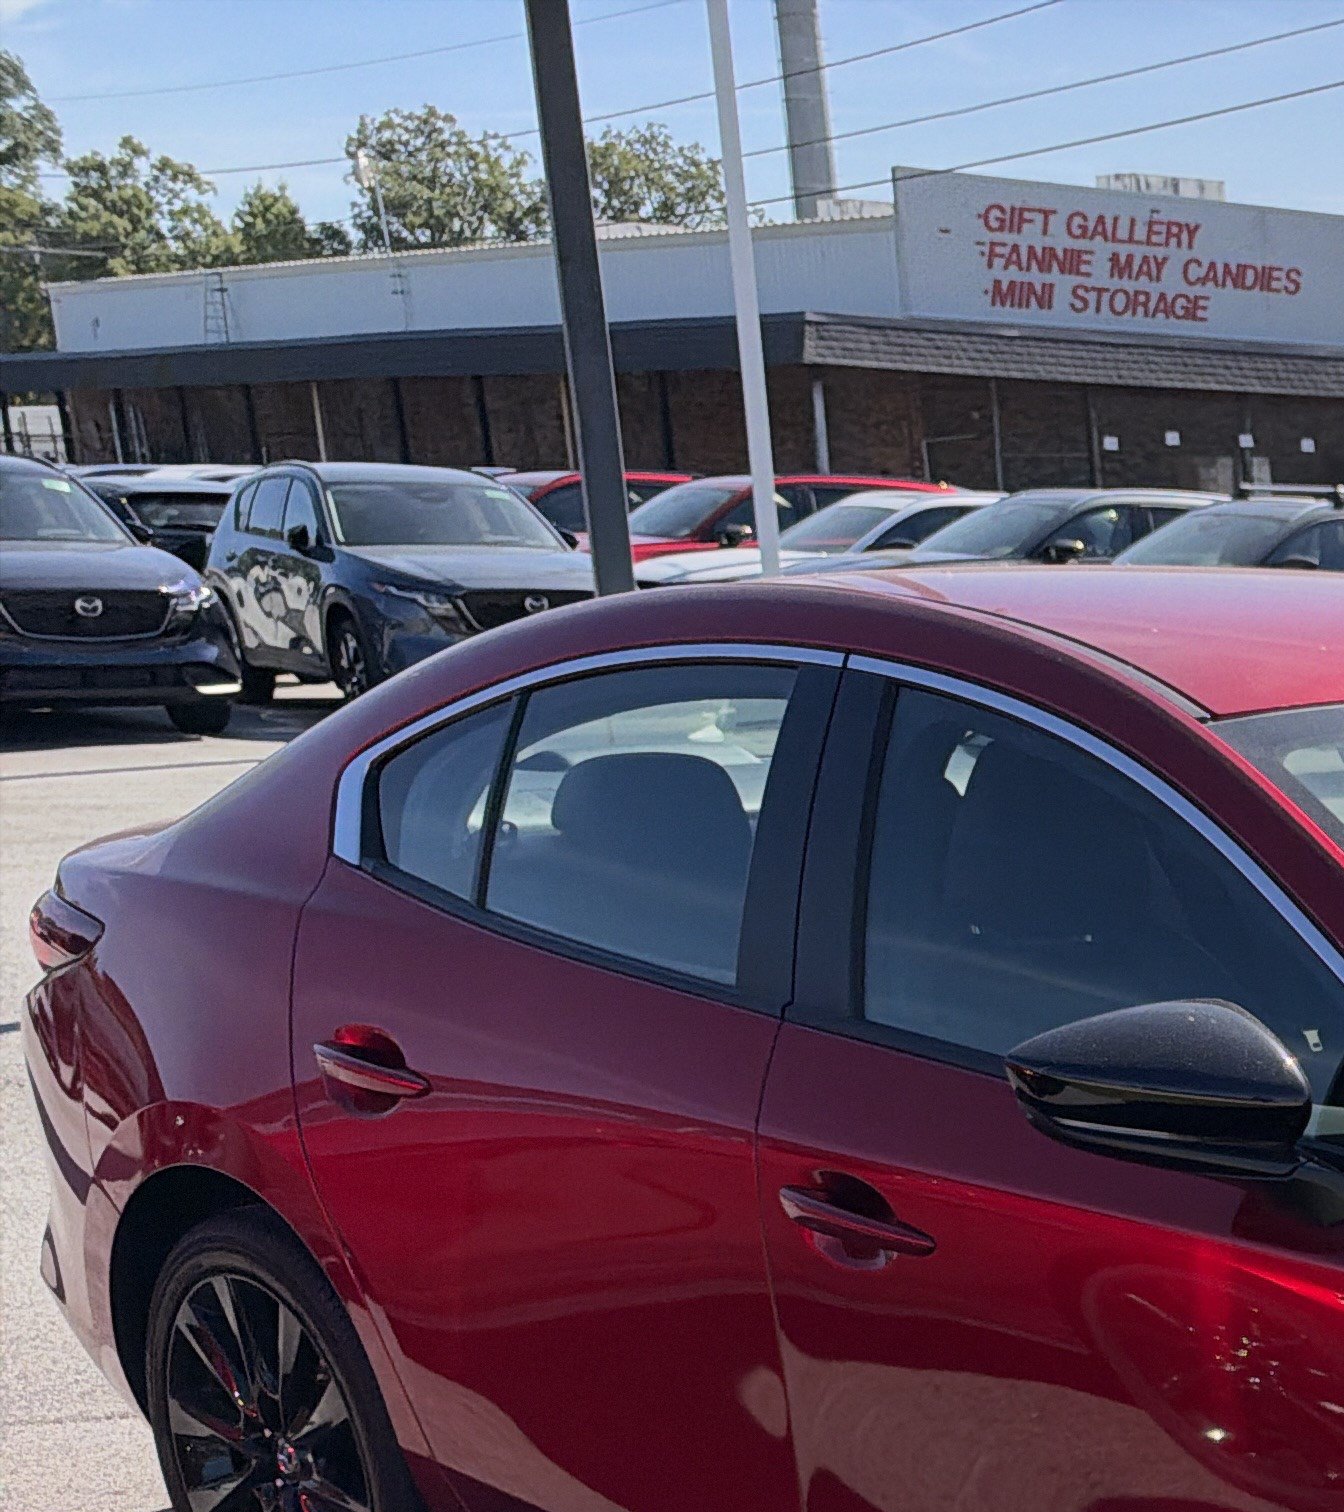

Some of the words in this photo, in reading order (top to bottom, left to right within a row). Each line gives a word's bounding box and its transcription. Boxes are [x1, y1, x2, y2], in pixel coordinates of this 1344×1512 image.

[982, 203, 1057, 236] GIFT
[1066, 211, 1201, 250] GALLERY
[986, 240, 1094, 278] FANNIE
[1108, 252, 1169, 283] MAY
[1182, 259, 1302, 296] CANDIES
[990, 279, 1055, 310] MINI
[1069, 285, 1210, 322] STORAGE
